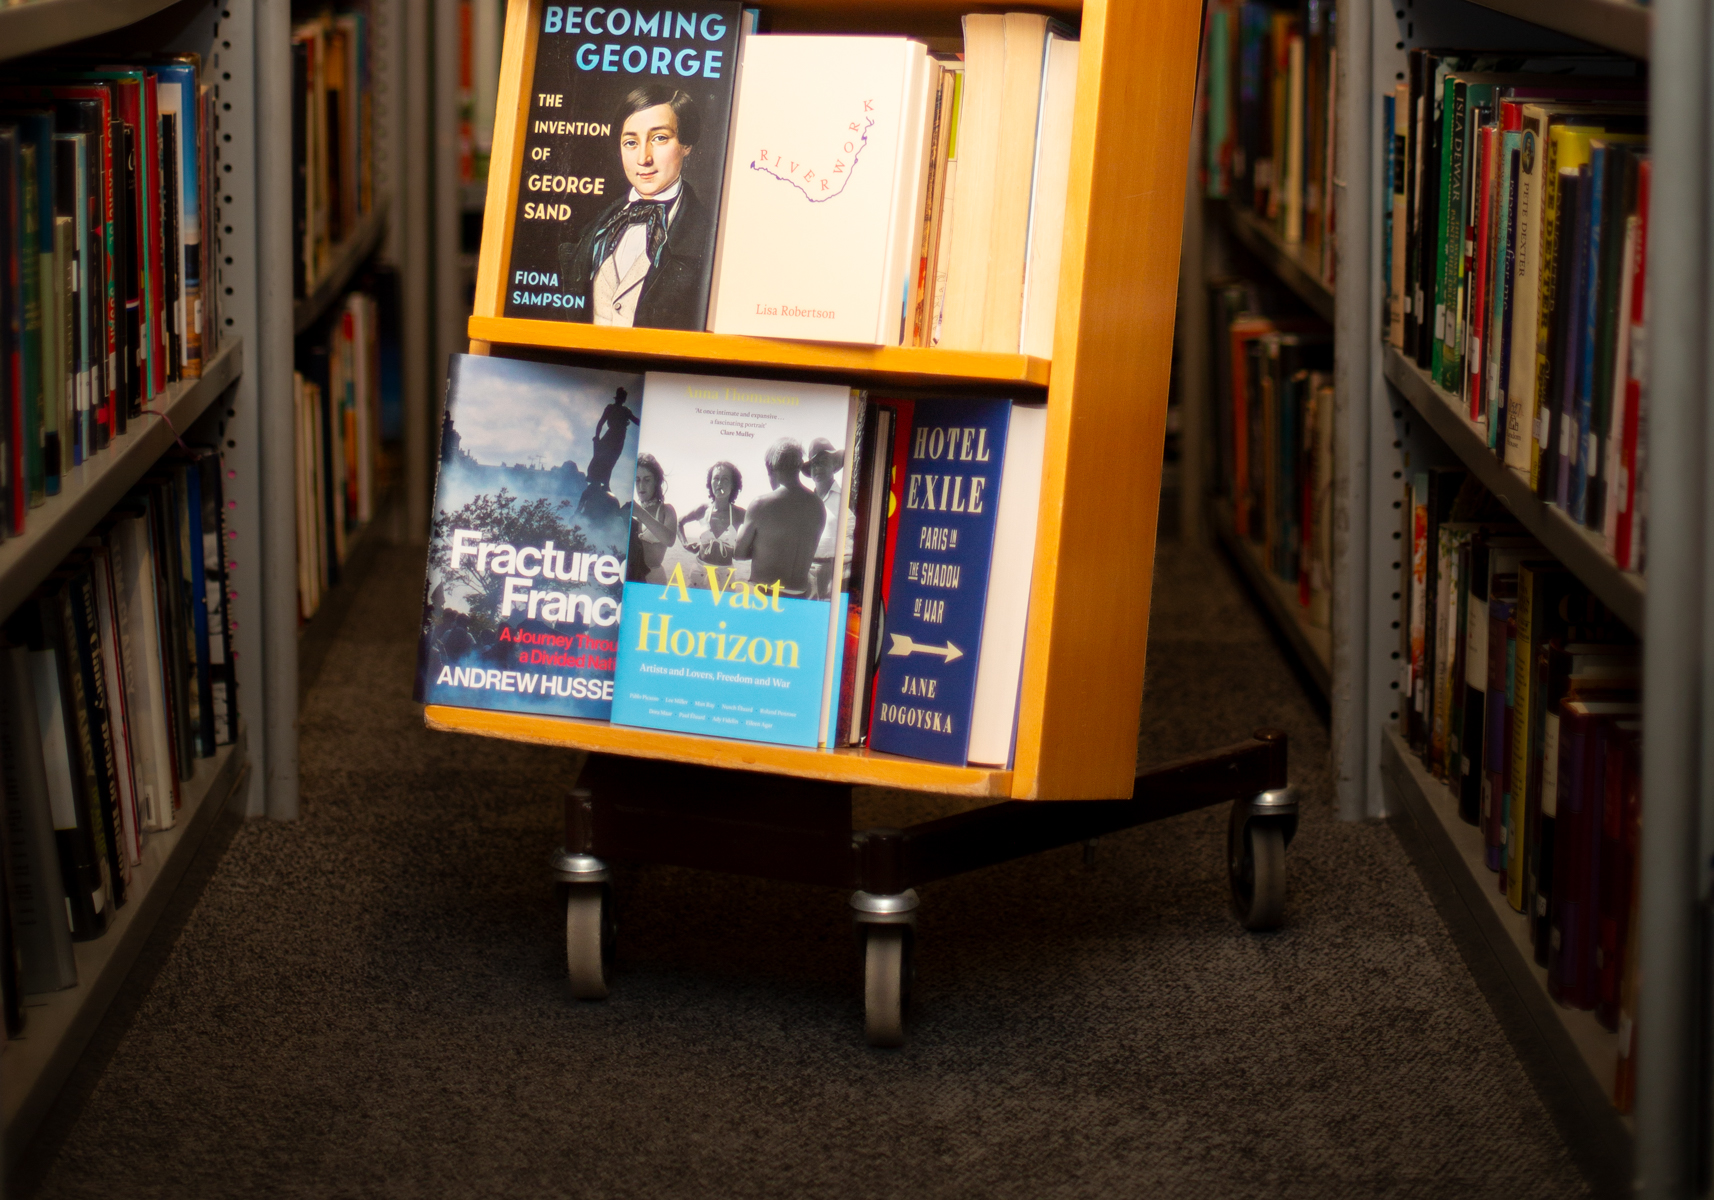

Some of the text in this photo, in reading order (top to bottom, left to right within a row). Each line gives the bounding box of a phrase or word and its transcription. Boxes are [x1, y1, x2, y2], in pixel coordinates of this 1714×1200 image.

[543, 5, 727, 42] BECOMING
[575, 42, 724, 79] GEORGE
[538, 93, 563, 108] THE
[534, 120, 611, 137] INVENTION
[531, 146, 551, 161] OF
[760, 99, 875, 192] RIVERWORK
[1452, 95, 1465, 202] ISLA DEWAR
[527, 174, 605, 195] GEORGE
[523, 202, 572, 221] SAND
[1518, 182, 1530, 278] PETE DEXTER
[1541, 139, 1559, 330] PETE DEXTER
[515, 270, 559, 287] FIONA
[512, 290, 586, 309] SAMPSON
[755, 303, 836, 320] Lisa Robertson
[683, 384, 800, 406] Anna Thomasson
[714, 419, 744, 428] fascinating
[716, 409, 740, 417] intimate
[735, 430, 755, 438] Mulley
[913, 426, 990, 462] HOTEL
[906, 474, 986, 514] EXILE
[919, 526, 949, 551] PARIS
[658, 561, 785, 613] A Vast
[908, 561, 961, 589] THE SHADOW
[913, 598, 945, 624] OF WAR
[81, 581, 104, 711] Tom Clancy
[499, 628, 618, 652] A Journey Throu
[635, 611, 801, 670] Horizon
[519, 649, 616, 672] a Divided Nati
[437, 665, 615, 702] ANDREW HUSSE
[639, 663, 791, 689] Artists and Lovers, Freedom and War
[901, 675, 938, 699] JANE
[73, 673, 95, 777] CLANCY
[879, 702, 953, 735] ROGOYSKA
